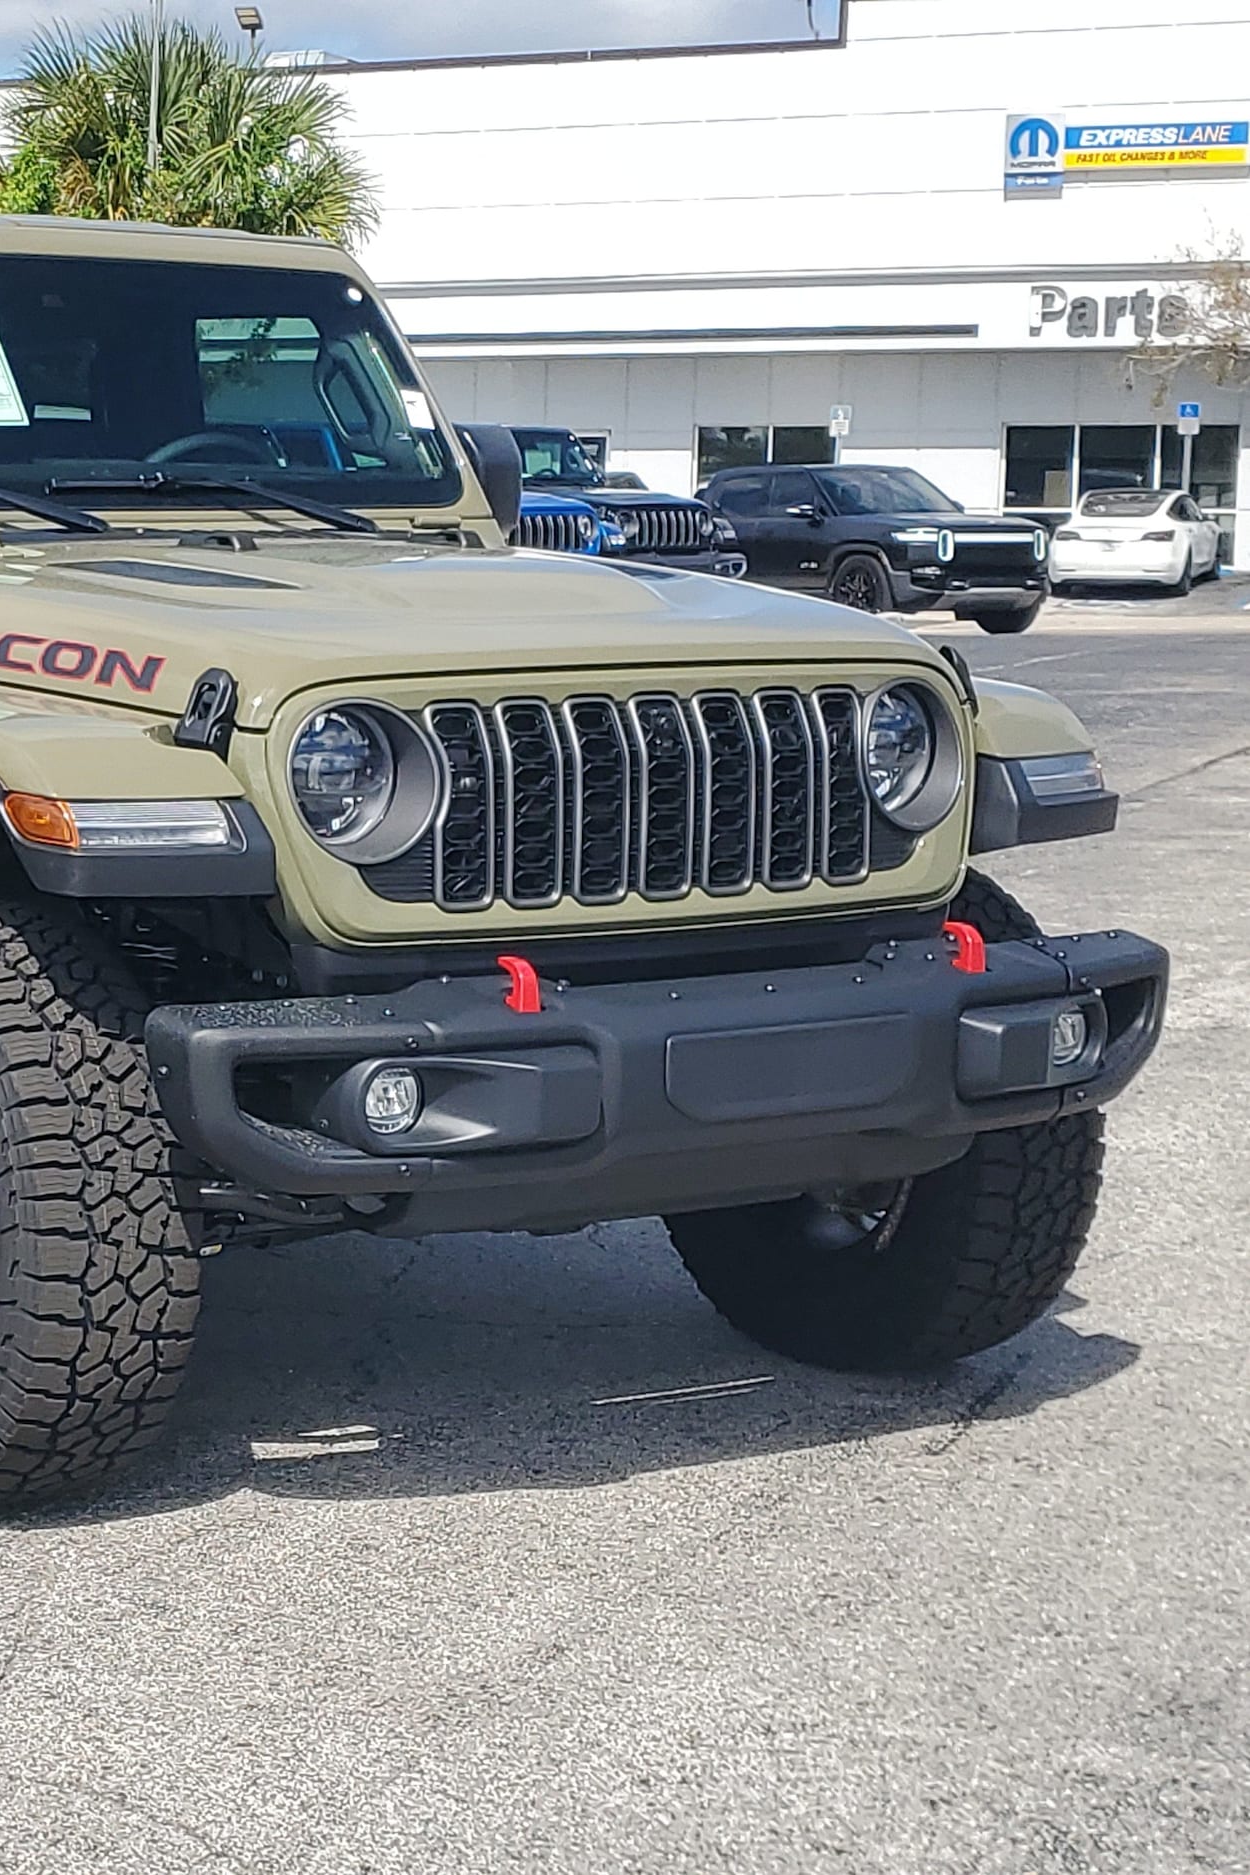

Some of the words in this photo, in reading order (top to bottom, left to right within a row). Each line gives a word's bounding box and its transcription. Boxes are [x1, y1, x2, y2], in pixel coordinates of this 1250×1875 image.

[1076, 152, 1100, 163] FAST
[1102, 152, 1116, 162] OIL
[1119, 151, 1168, 162] CHANGES
[1178, 150, 1209, 160] MORE
[1028, 284, 1190, 338] Parts
